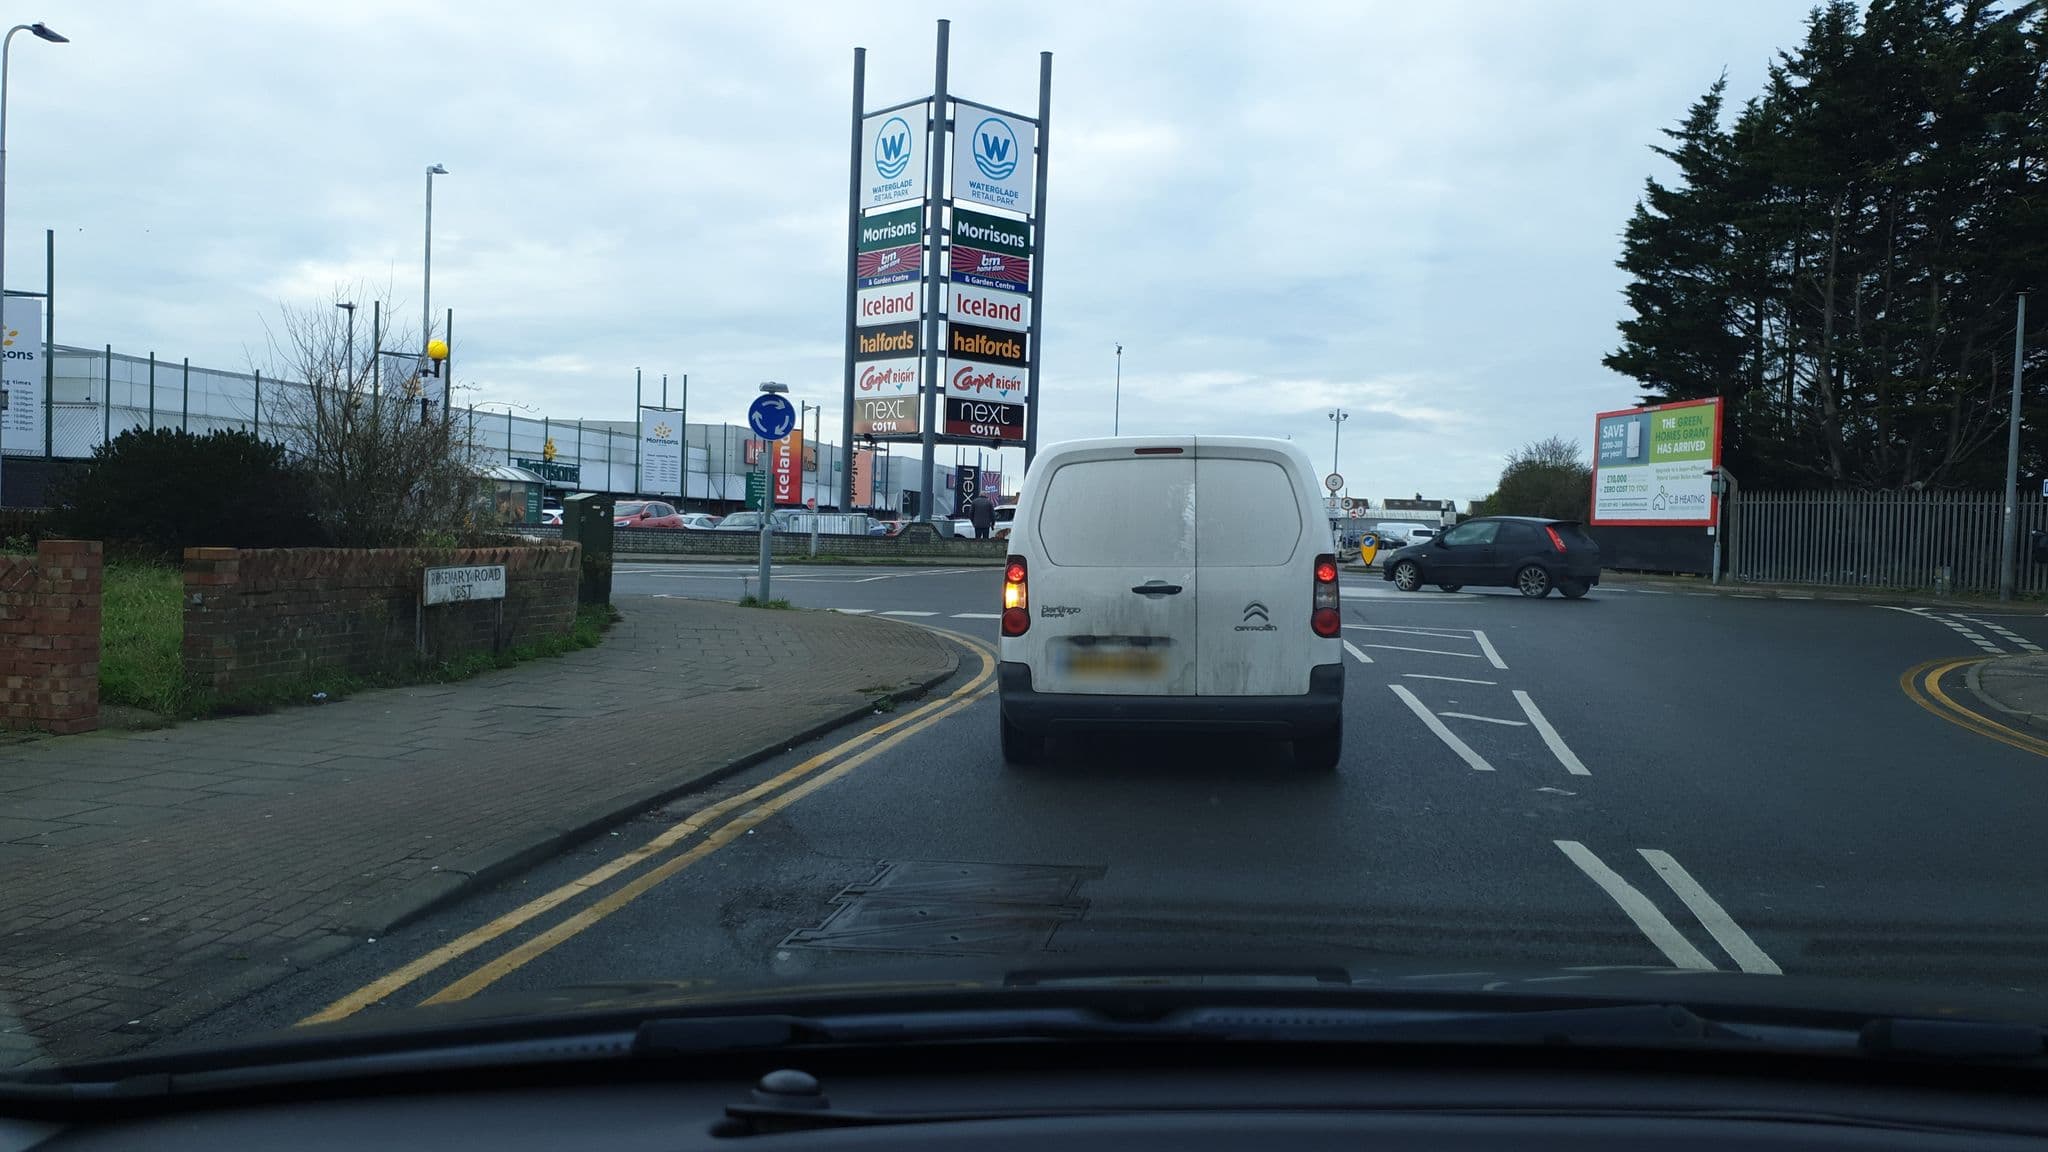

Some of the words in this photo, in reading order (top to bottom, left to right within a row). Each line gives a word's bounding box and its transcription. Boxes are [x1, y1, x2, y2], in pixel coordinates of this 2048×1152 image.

[882, 132, 905, 161] W
[981, 132, 1011, 161] W
[872, 179, 913, 194] WATERGLADE
[873, 190, 893, 201] RETAIL
[893, 189, 909, 199] PARK
[968, 180, 1019, 198] WATERGLADE
[971, 190, 996, 202] RETAIL
[996, 195, 1015, 206] PARK
[863, 221, 917, 243] Morrisons
[957, 221, 1025, 248] Morrisons
[873, 277, 892, 285] Garden
[892, 274, 909, 282] Centre
[971, 277, 994, 287] Garden
[994, 281, 1016, 291] Centre
[862, 292, 914, 317] Iceland
[957, 293, 1021, 322] Iceland
[860, 331, 914, 353] halfords
[954, 331, 1021, 359] halfords
[953, 366, 995, 393] Carpet
[864, 400, 905, 420] next
[960, 402, 1010, 425] next
[872, 422, 897, 432] COSTA
[970, 424, 1001, 436] COSTA
[1662, 417, 1676, 429] THE
[1677, 415, 1703, 427] GREEN
[1602, 424, 1624, 439] SAVE
[1655, 431, 1681, 441] HOMES
[1682, 427, 1710, 439] GRANT
[1656, 443, 1671, 454] HAS
[1672, 440, 1706, 453] ARRIVED
[1603, 485, 1615, 493] ZERO
[1616, 485, 1627, 493] COST
[1680, 494, 1706, 504] HEATING
[431, 569, 472, 586] ROSEMARY
[474, 568, 501, 582] ROAD
